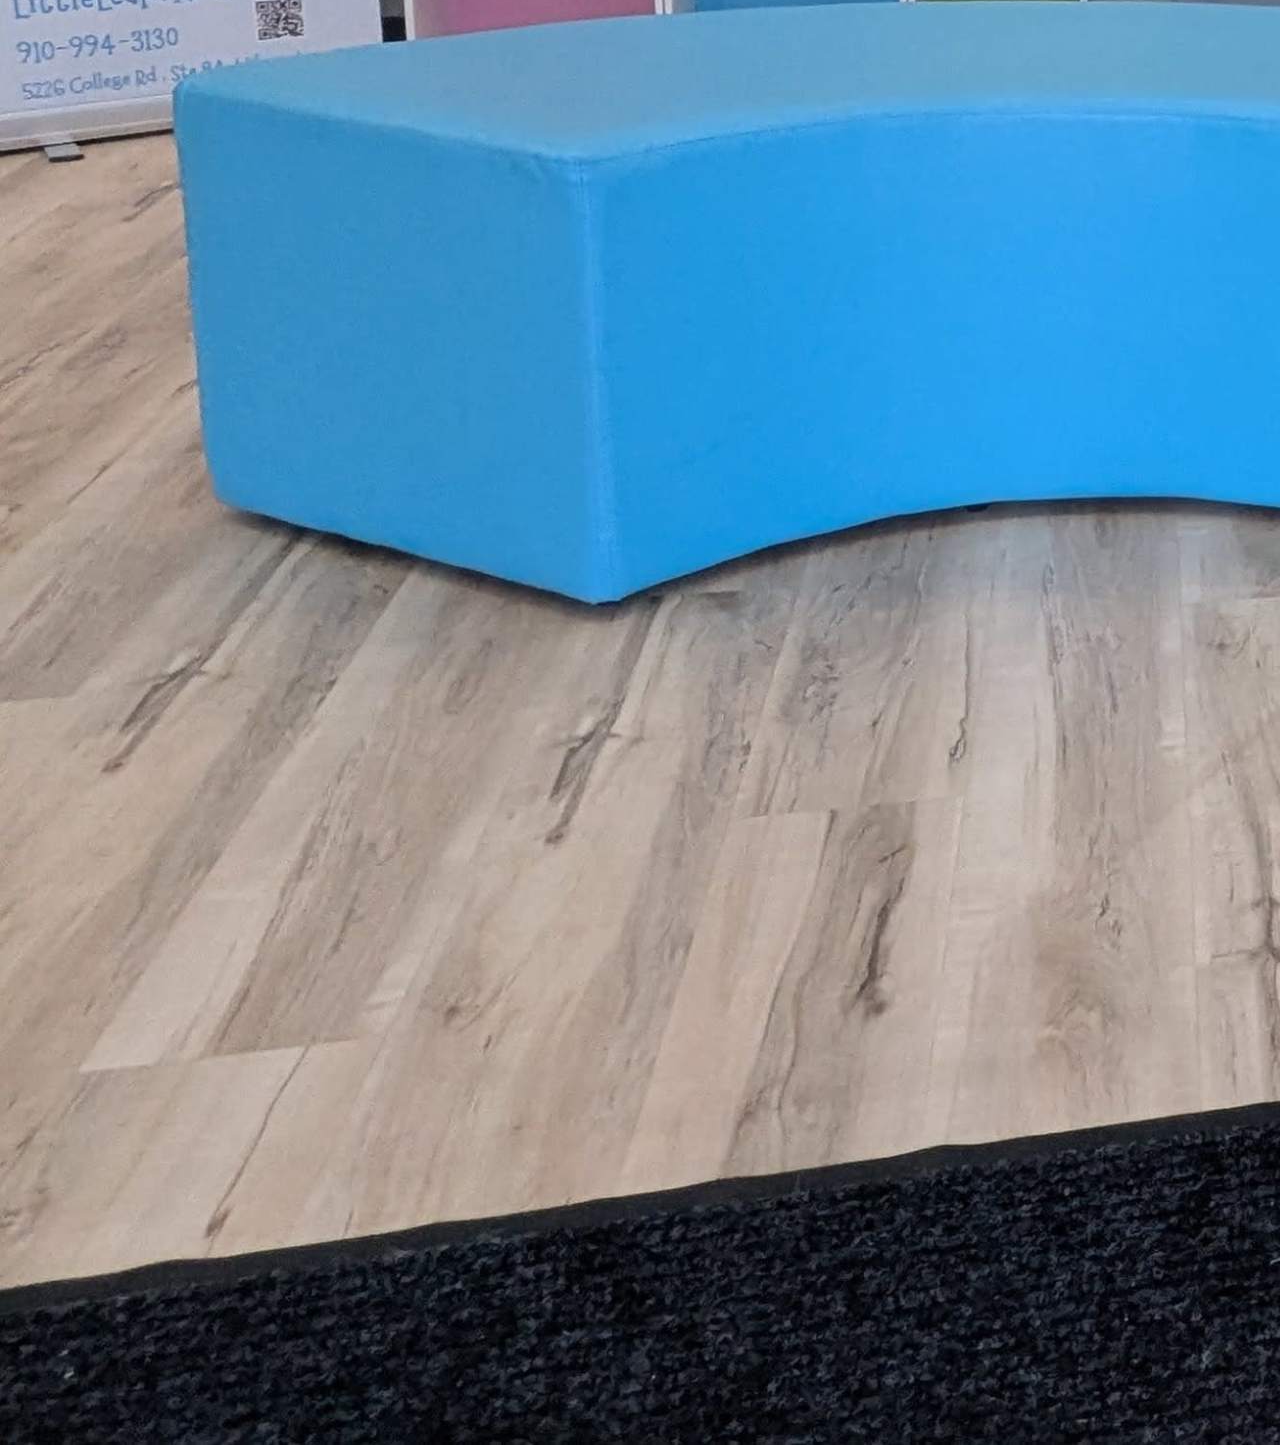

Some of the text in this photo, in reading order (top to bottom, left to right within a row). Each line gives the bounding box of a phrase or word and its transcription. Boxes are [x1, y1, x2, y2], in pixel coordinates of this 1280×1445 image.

[15, 27, 179, 64] 910-994-3130
[22, 80, 66, 100] 5226
[69, 71, 131, 95] College
